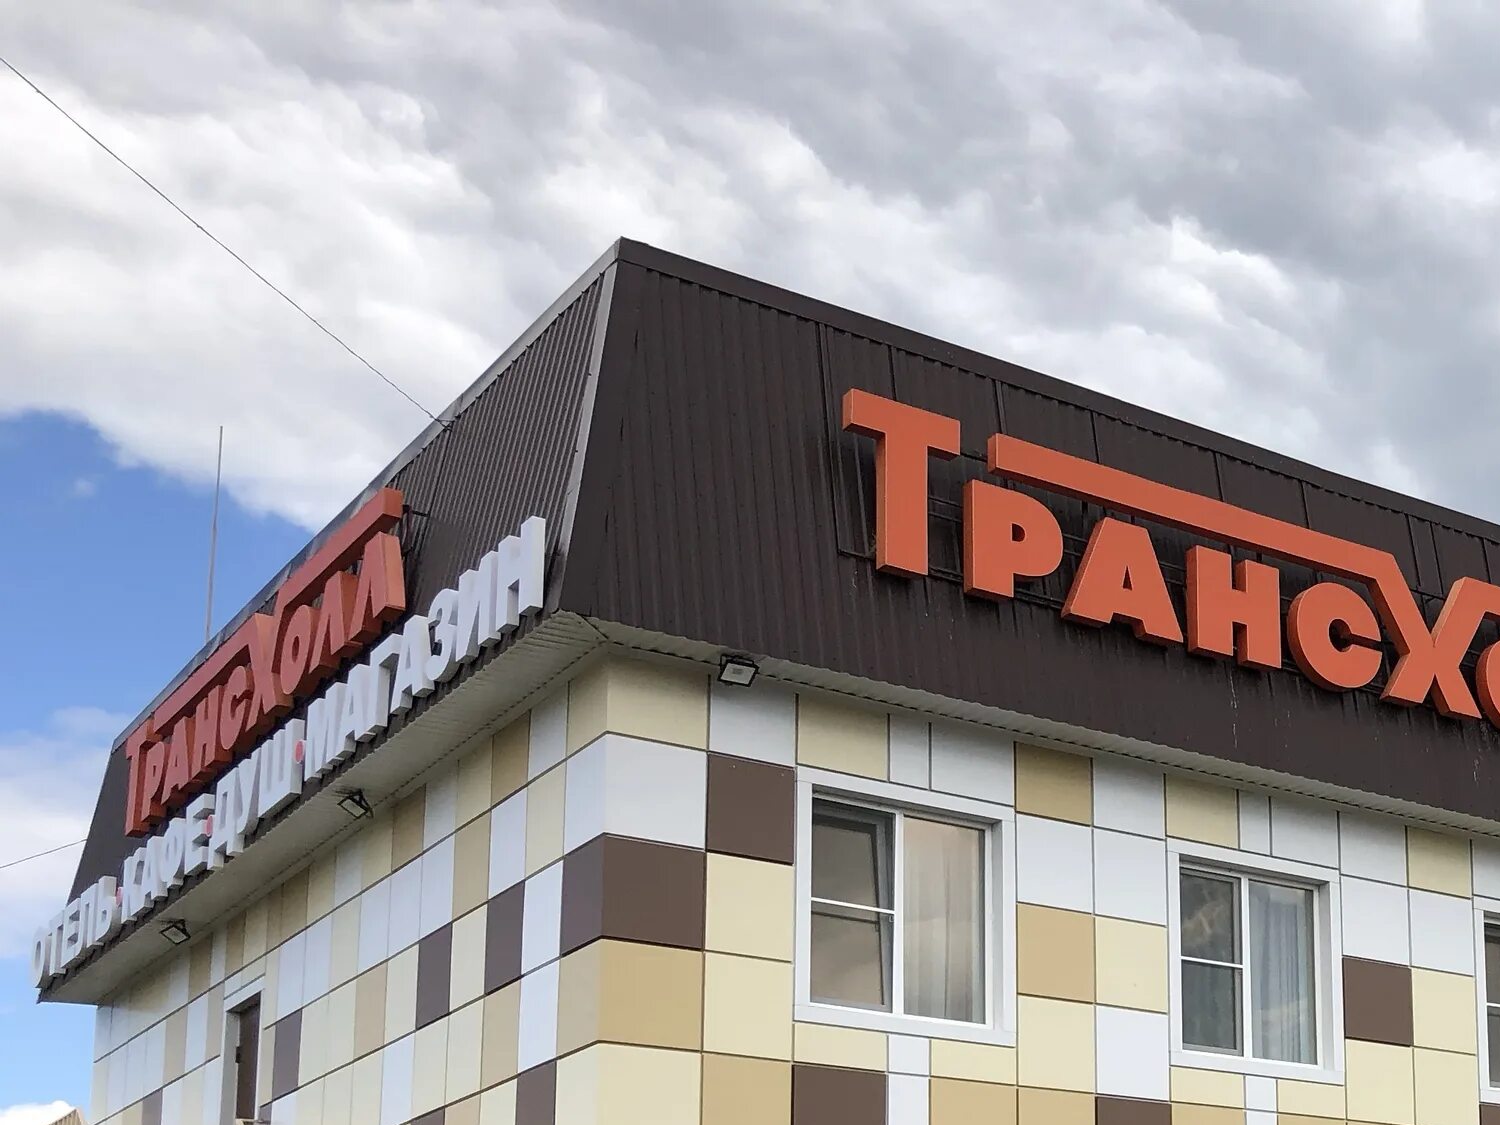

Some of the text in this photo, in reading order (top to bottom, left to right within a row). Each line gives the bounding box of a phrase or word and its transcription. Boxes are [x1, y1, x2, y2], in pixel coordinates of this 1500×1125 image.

[31, 516, 546, 988] ОТЕЛЬ КАФЕ ДУШ МАГАЗИН
